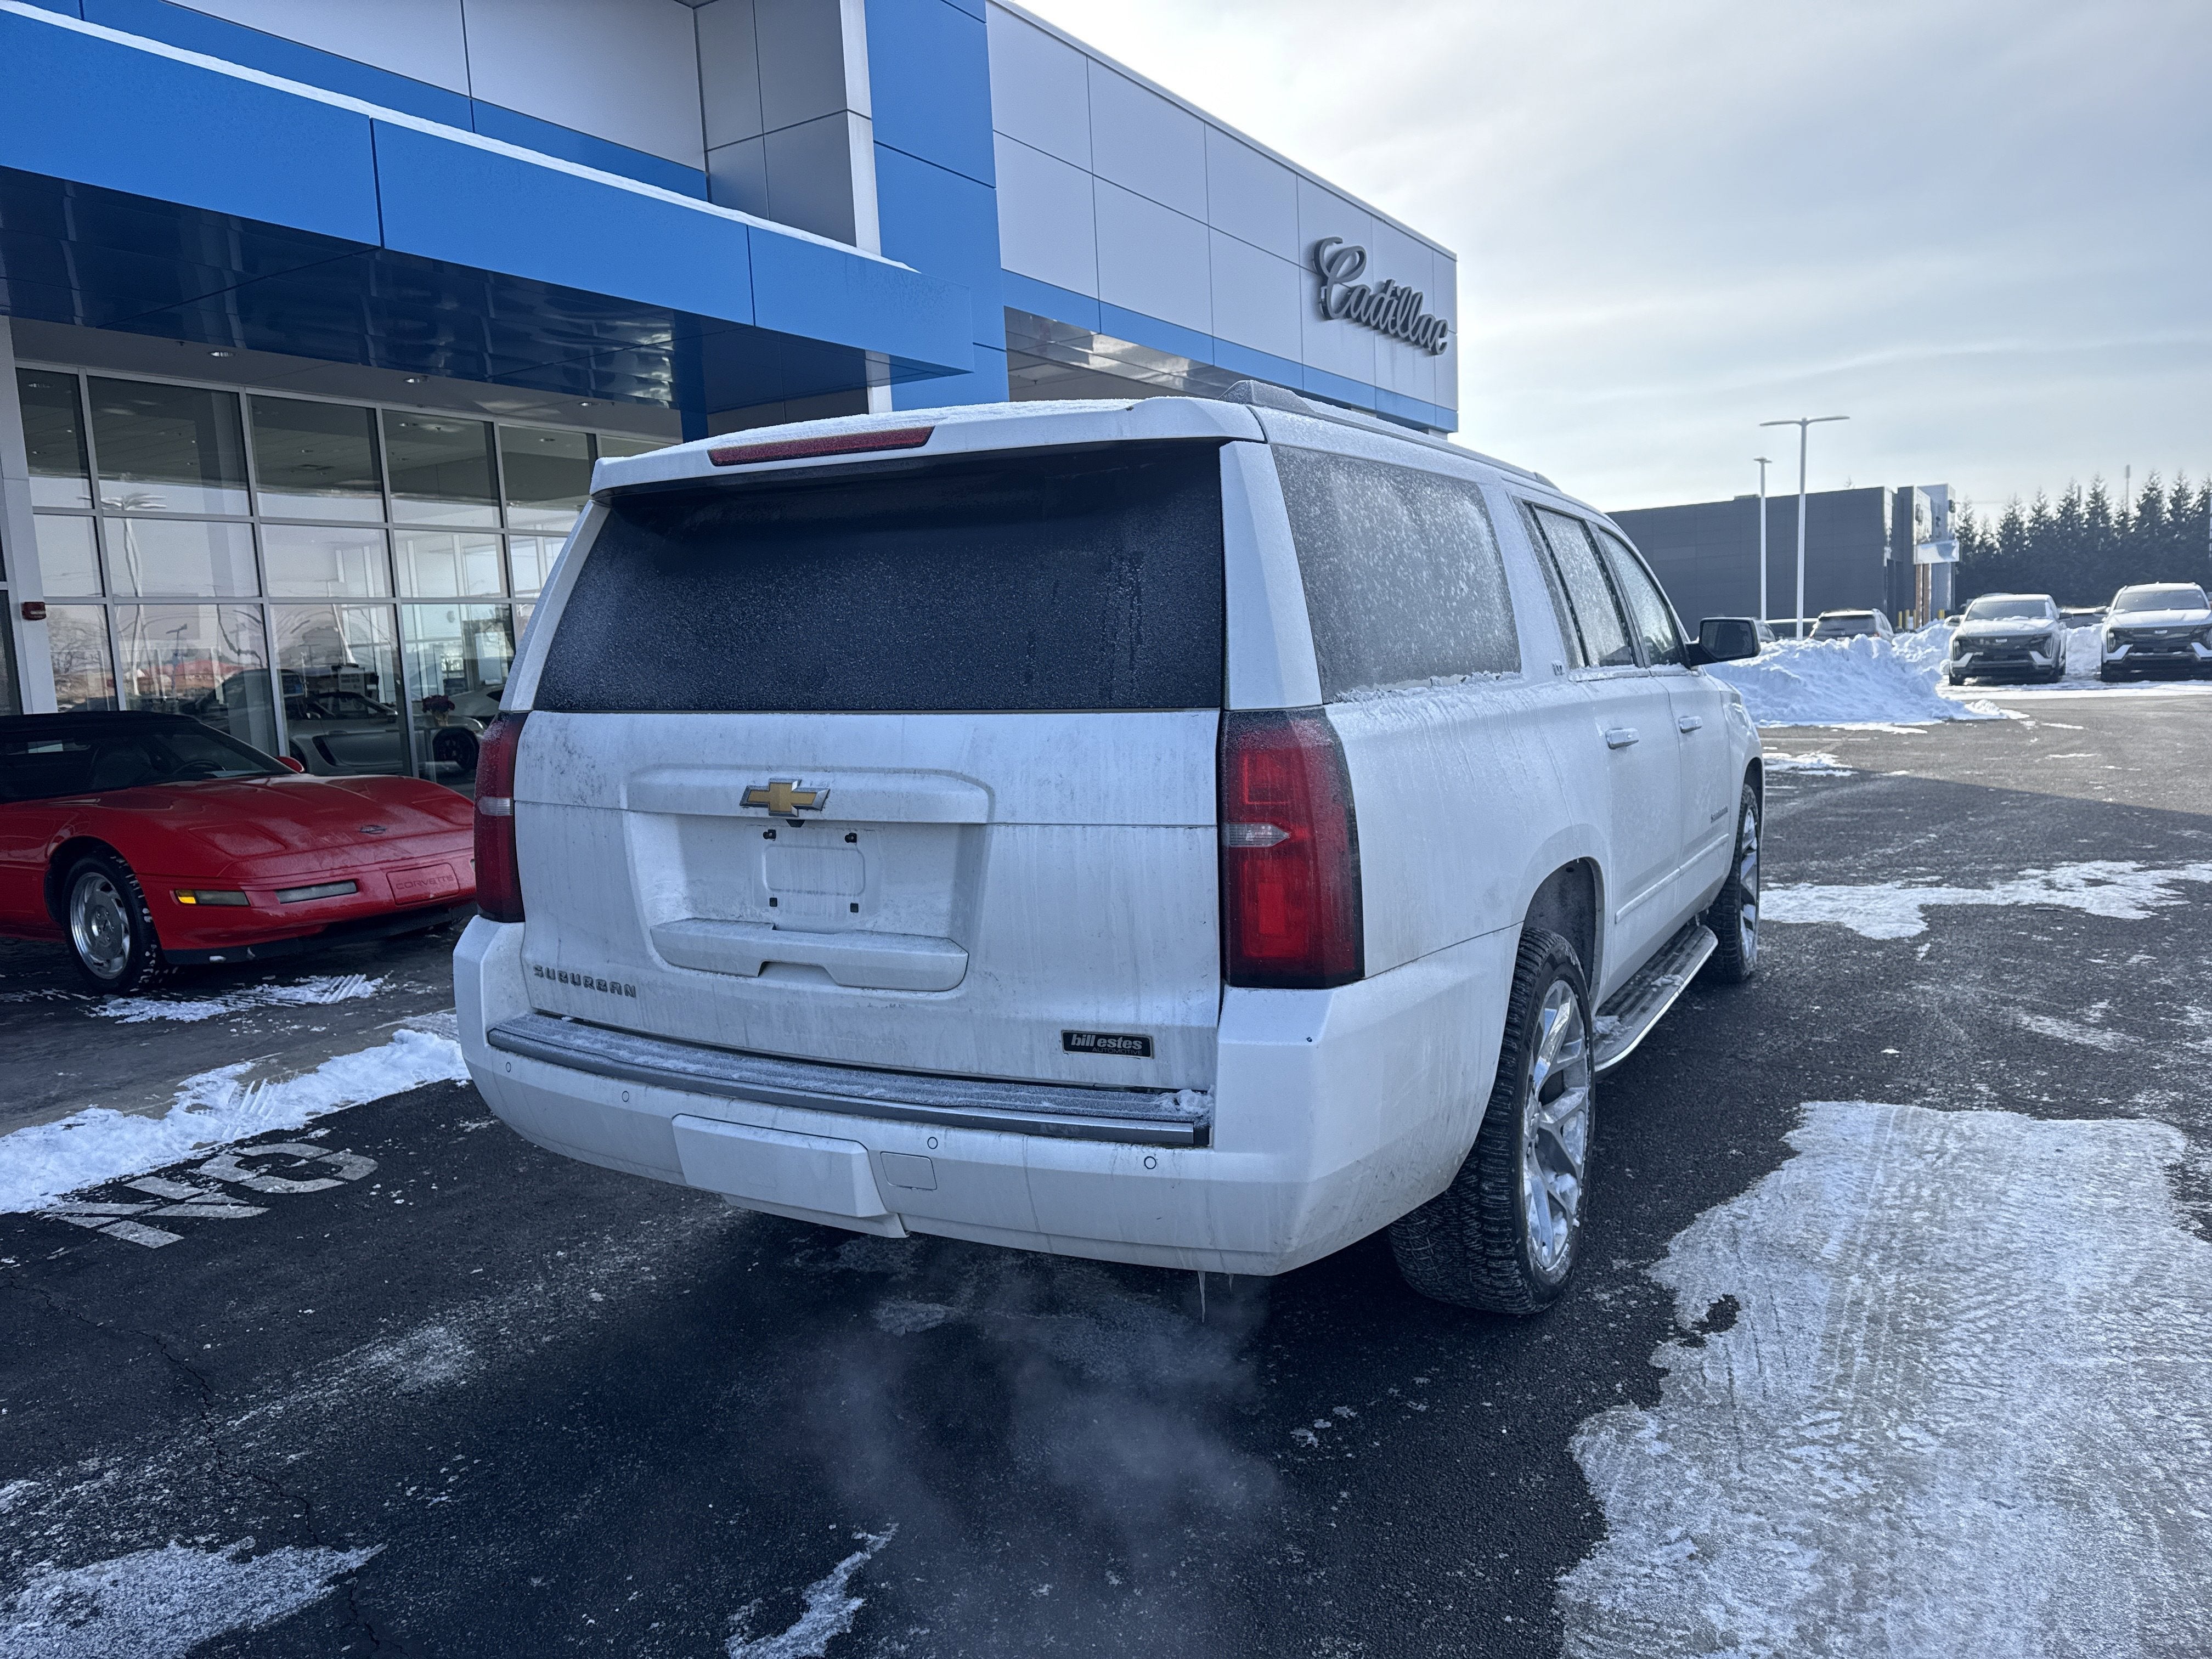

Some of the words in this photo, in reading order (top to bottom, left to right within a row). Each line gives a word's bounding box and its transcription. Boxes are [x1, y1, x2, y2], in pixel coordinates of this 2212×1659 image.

[1314, 236, 1448, 356] Cadillac
[396, 874, 454, 889] CORVETTE
[533, 964, 636, 998] SUBURBAN
[1071, 1034, 1096, 1046] bill
[1097, 1037, 1142, 1049] estes
[35, 1143, 379, 1249] NO
